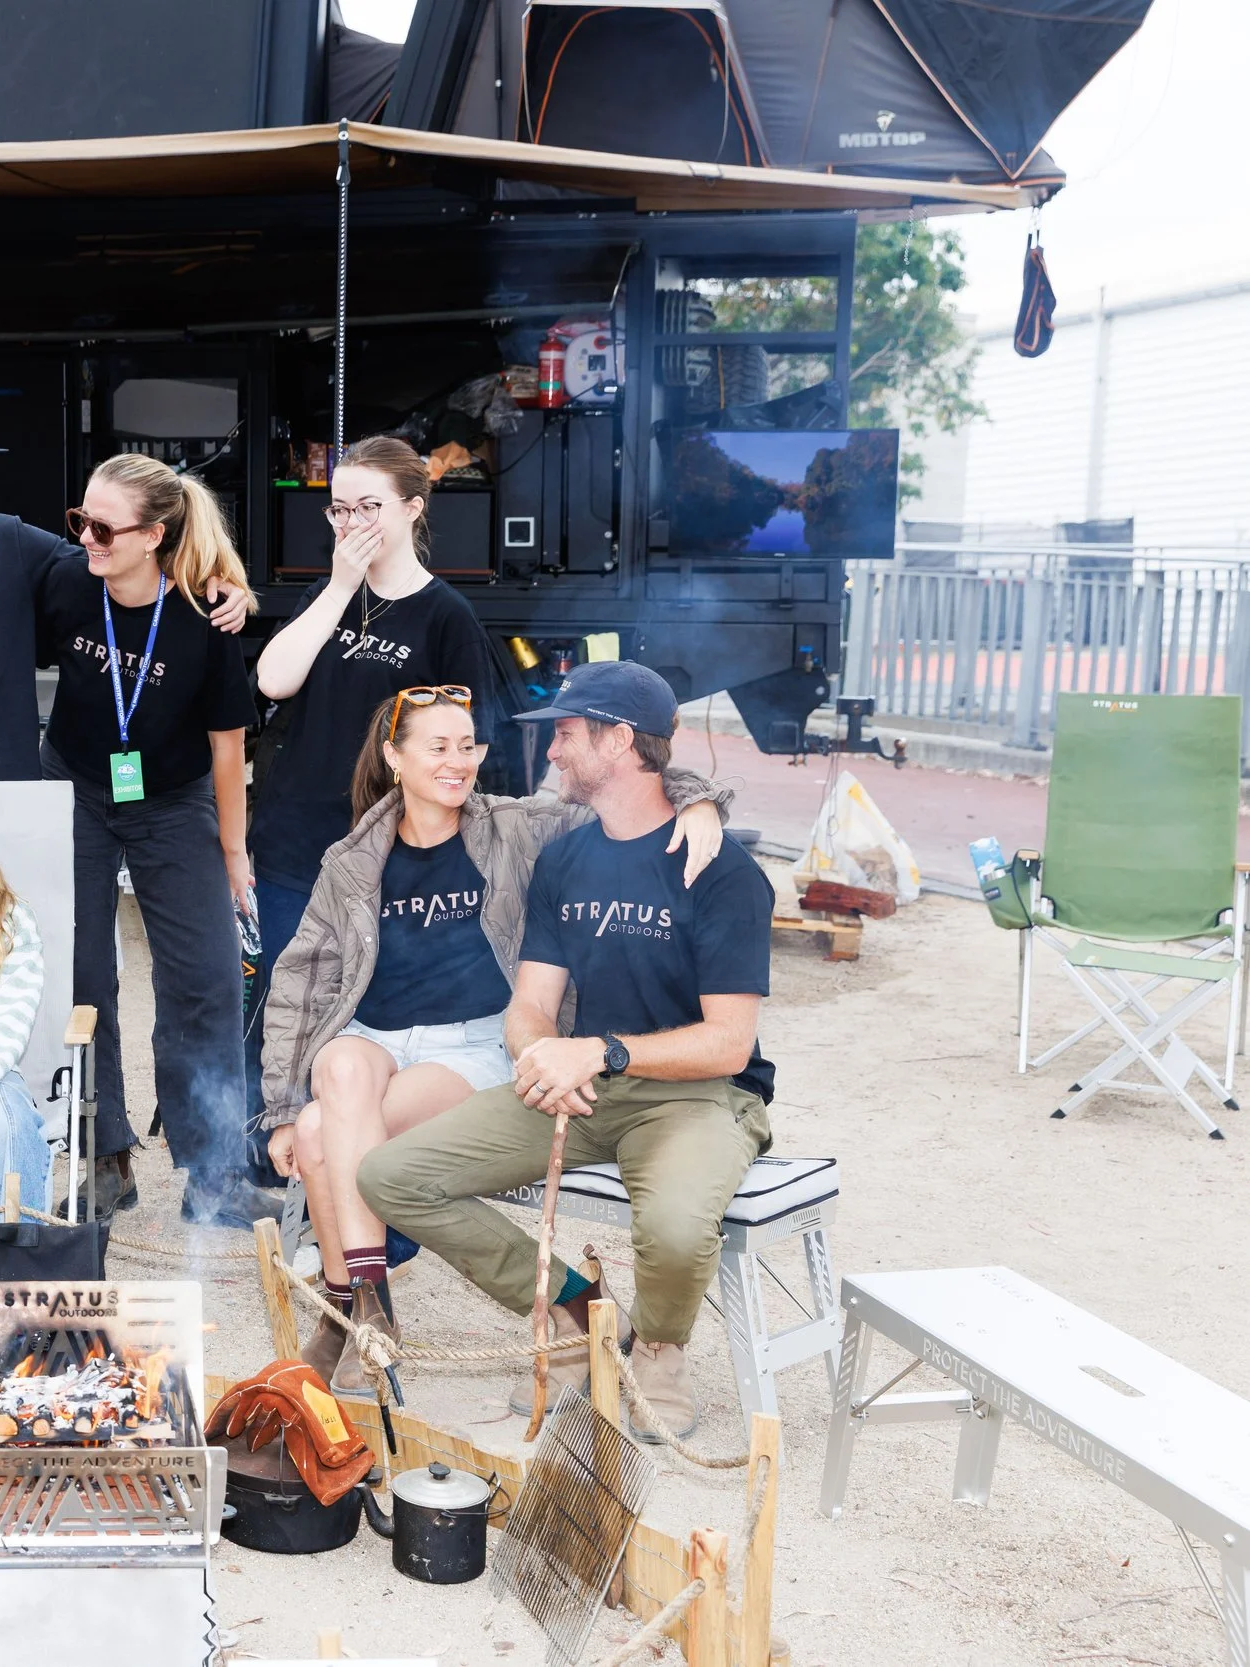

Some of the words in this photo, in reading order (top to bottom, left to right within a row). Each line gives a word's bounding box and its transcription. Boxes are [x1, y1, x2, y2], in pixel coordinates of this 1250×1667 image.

[838, 131, 927, 149] MOTOP
[140, 651, 151, 678] VICTORIA
[1092, 700, 1139, 713] STRATUS
[561, 900, 672, 937] STRATUS
[4, 1291, 119, 1317] STRATUS
[58, 1308, 118, 1318] OUTDOORS
[922, 1336, 988, 1394] PROTECT
[991, 1379, 1022, 1416] THE
[1022, 1403, 1127, 1483] ADVENTURE
[40, 1456, 75, 1468] THE
[81, 1456, 195, 1468] ADVENTURE
